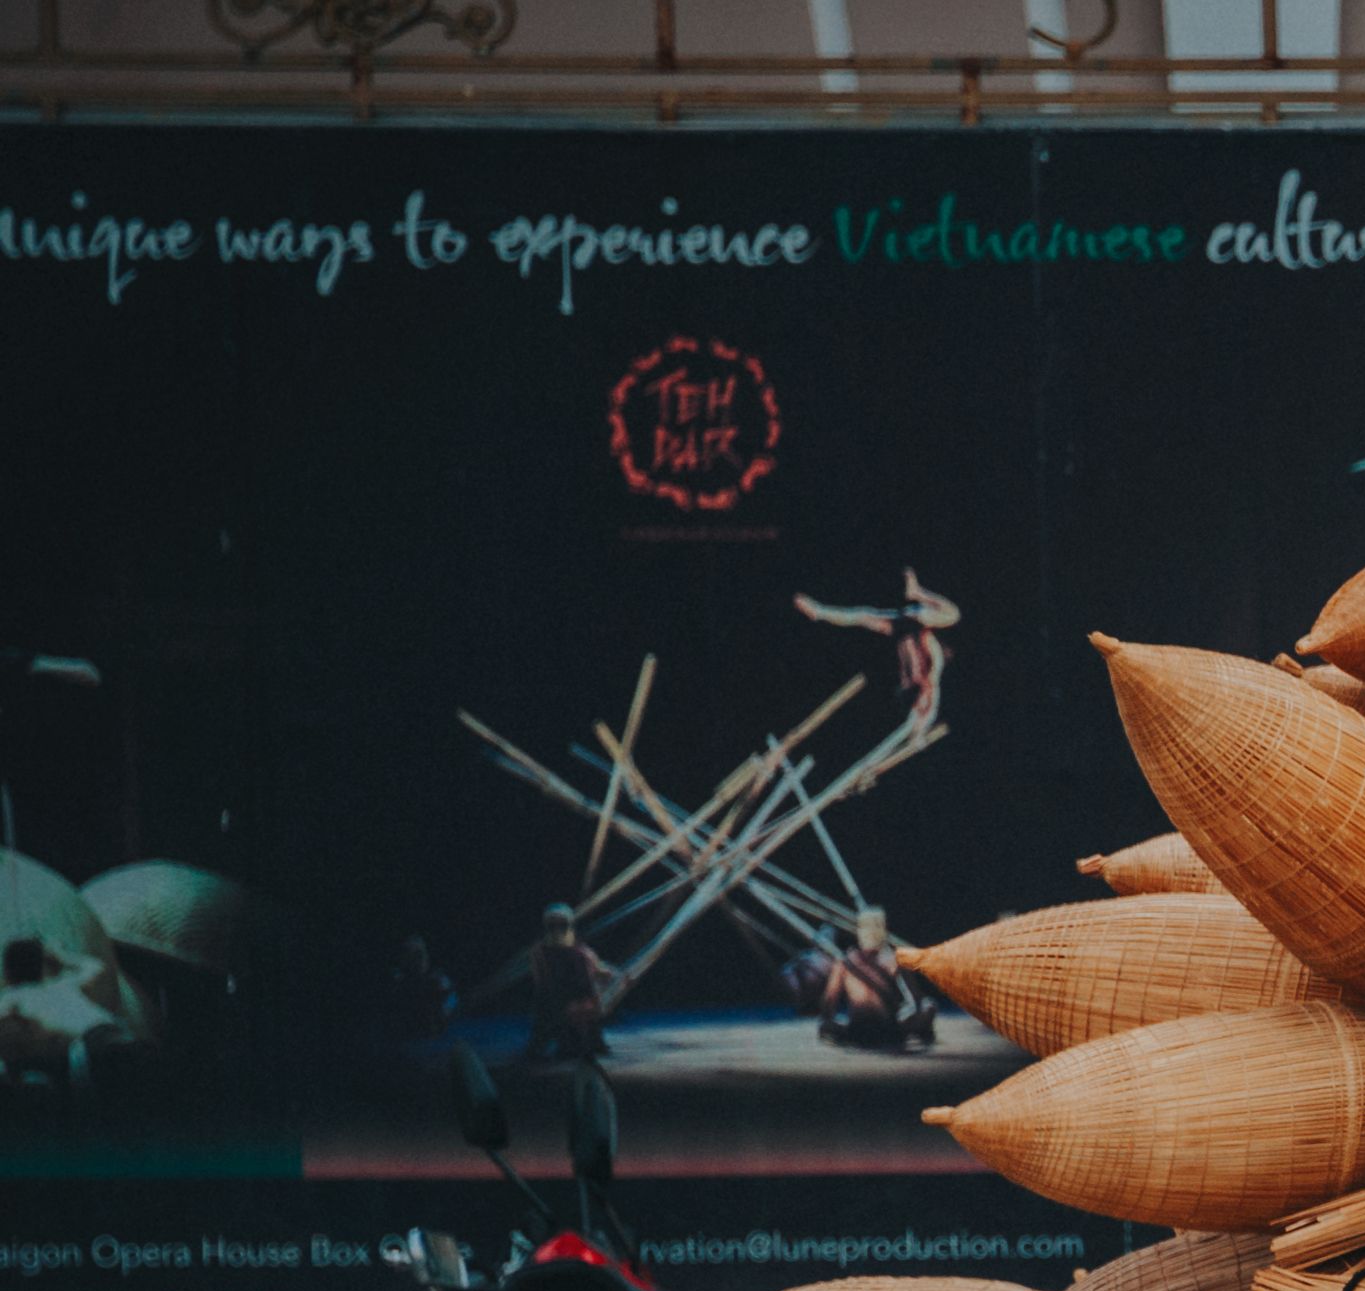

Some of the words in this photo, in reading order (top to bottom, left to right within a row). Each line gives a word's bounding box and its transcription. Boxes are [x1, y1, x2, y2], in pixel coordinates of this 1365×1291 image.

[215, 215, 375, 297] ways
[394, 190, 468, 269] to
[490, 196, 813, 315] experience
[833, 192, 1189, 268] Vietnamese
[90, 1233, 193, 1276] Opera
[200, 1233, 301, 1269] House
[310, 1234, 373, 1268] Box
